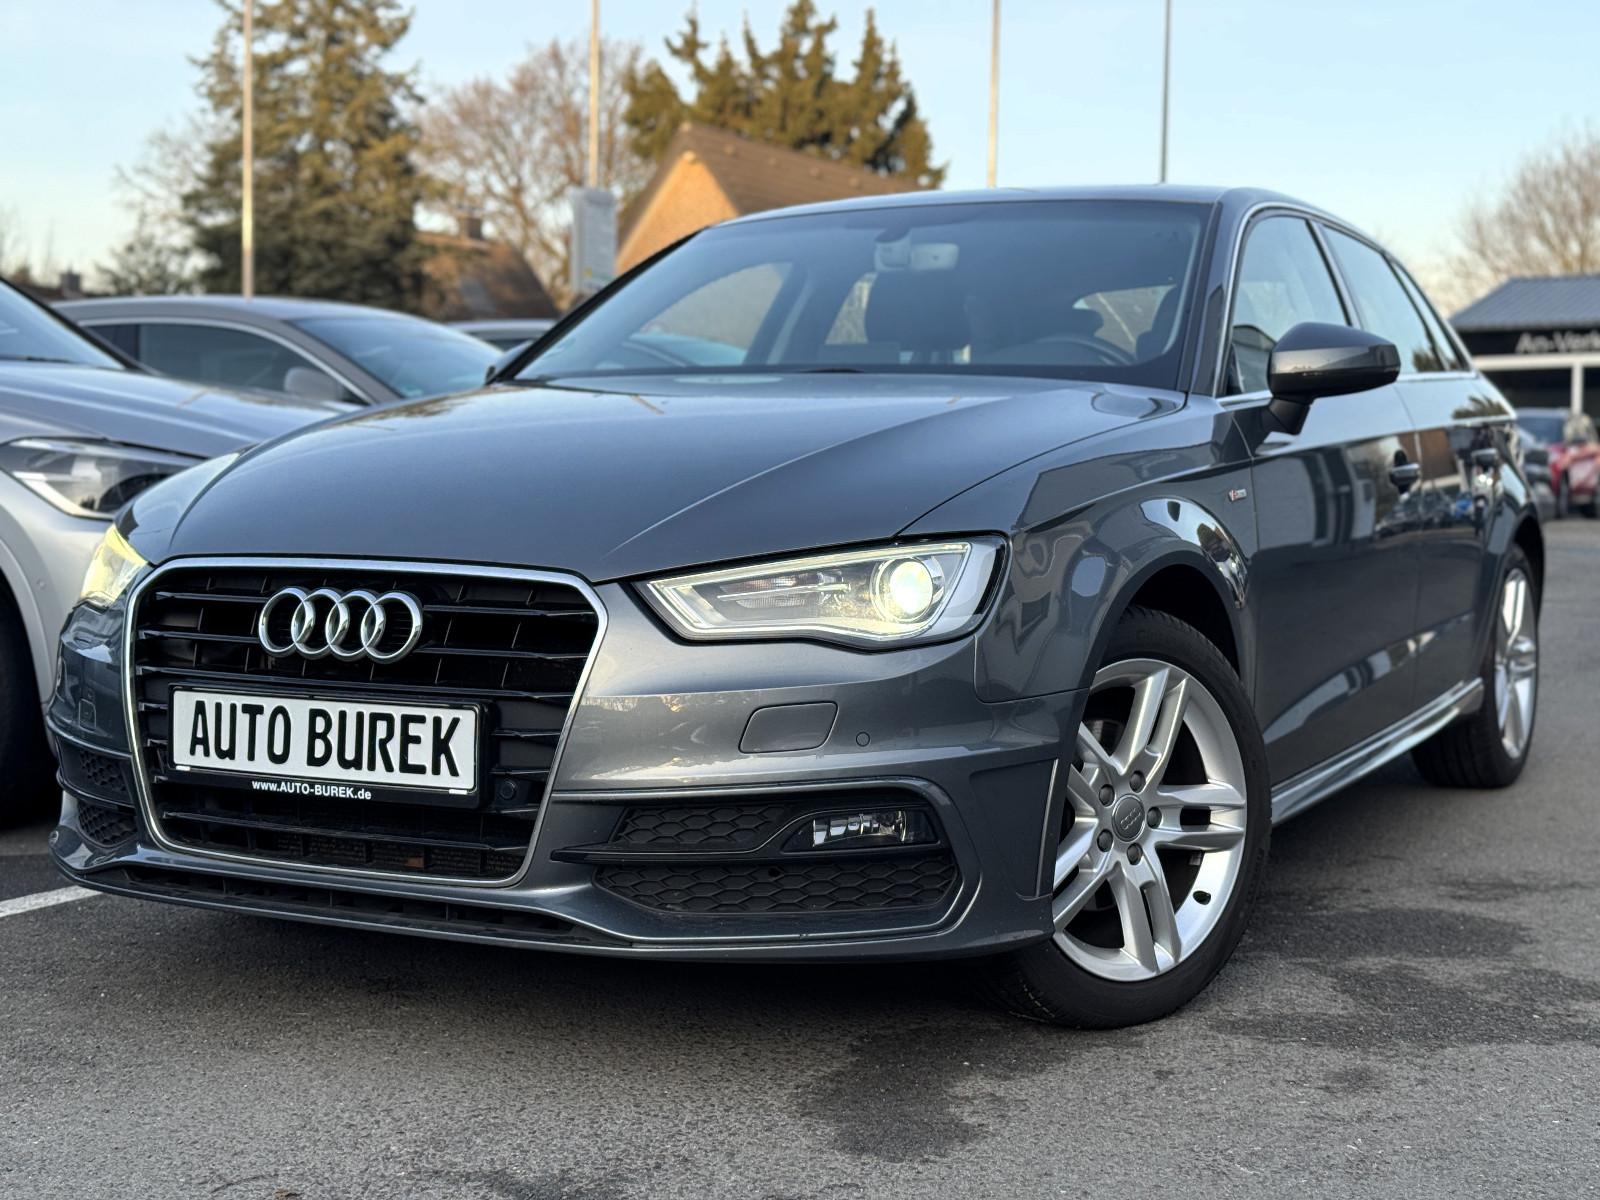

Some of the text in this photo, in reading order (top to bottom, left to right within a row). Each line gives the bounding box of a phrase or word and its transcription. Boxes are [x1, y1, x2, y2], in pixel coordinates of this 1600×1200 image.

[189, 700, 461, 777] AUTO BUREK
[252, 780, 372, 800] www.AUTO-BUREK.de
